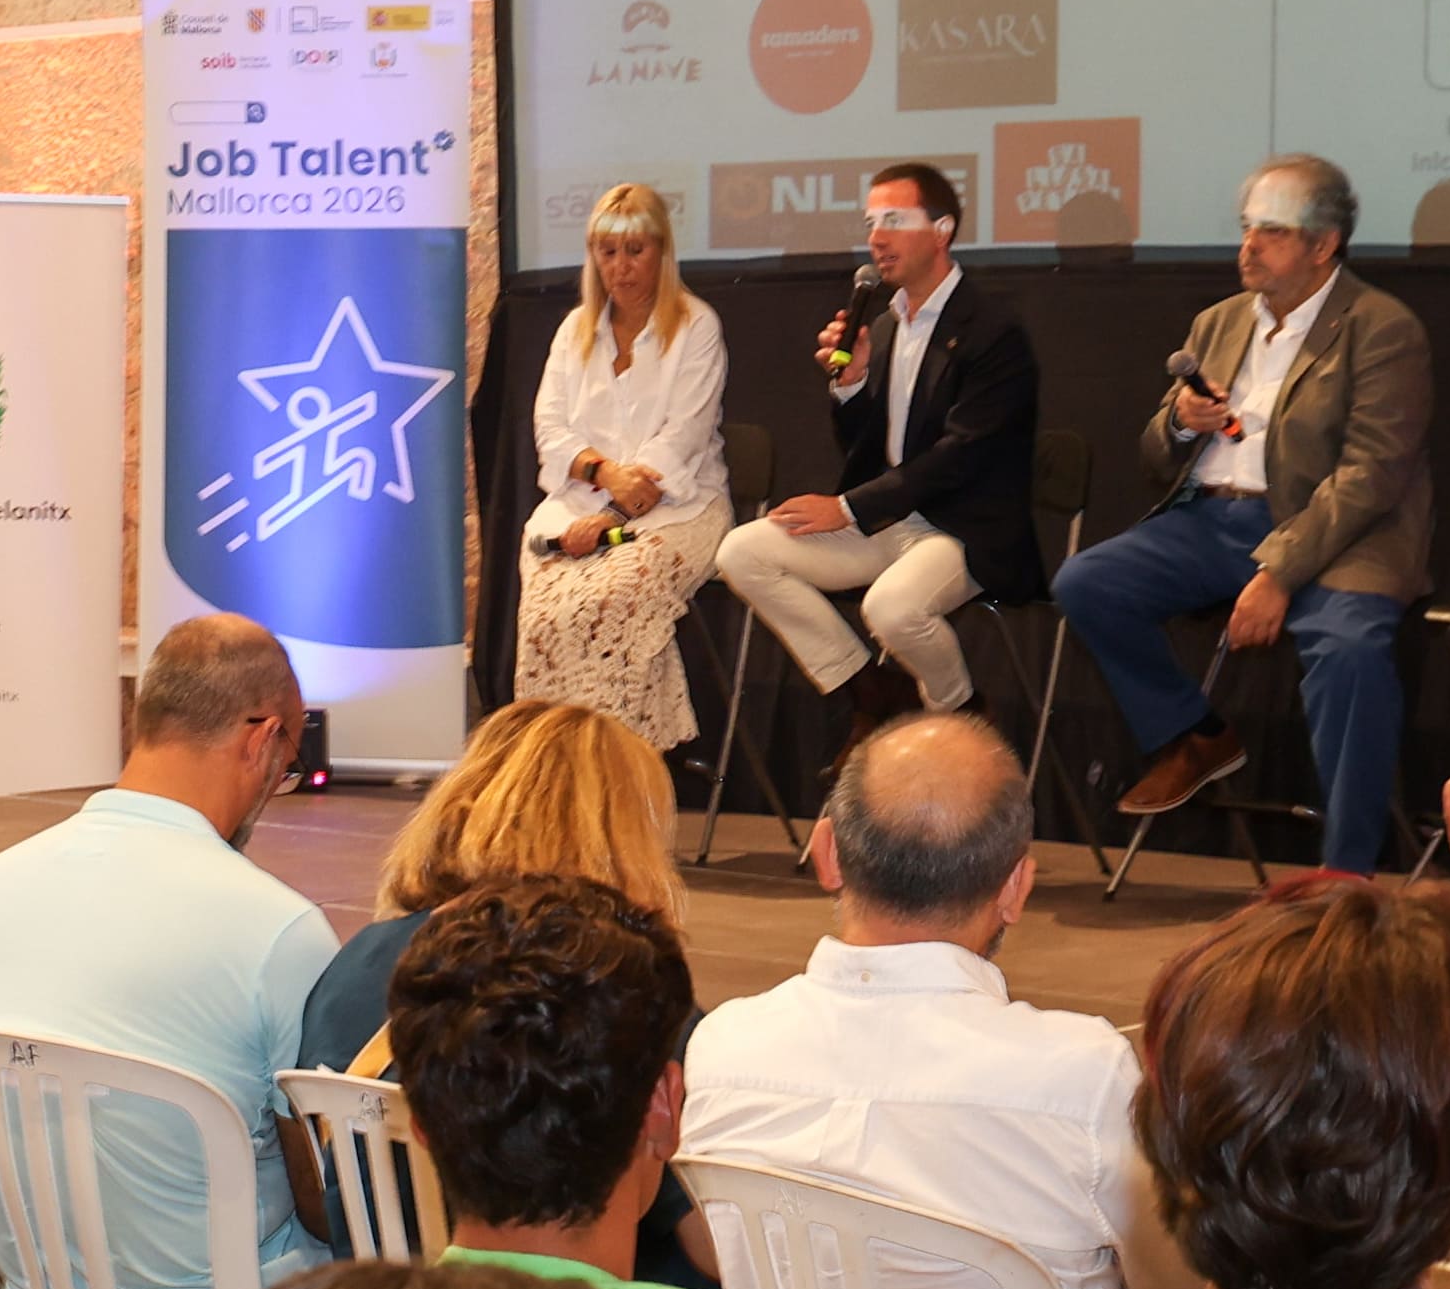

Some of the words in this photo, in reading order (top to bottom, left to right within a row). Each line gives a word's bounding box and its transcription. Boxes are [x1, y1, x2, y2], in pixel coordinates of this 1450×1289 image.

[899, 14, 1047, 58] KASARA
[166, 139, 256, 178] Job
[269, 138, 430, 177] Talent
[165, 187, 313, 216] Mallorca
[322, 185, 407, 215] 2026
